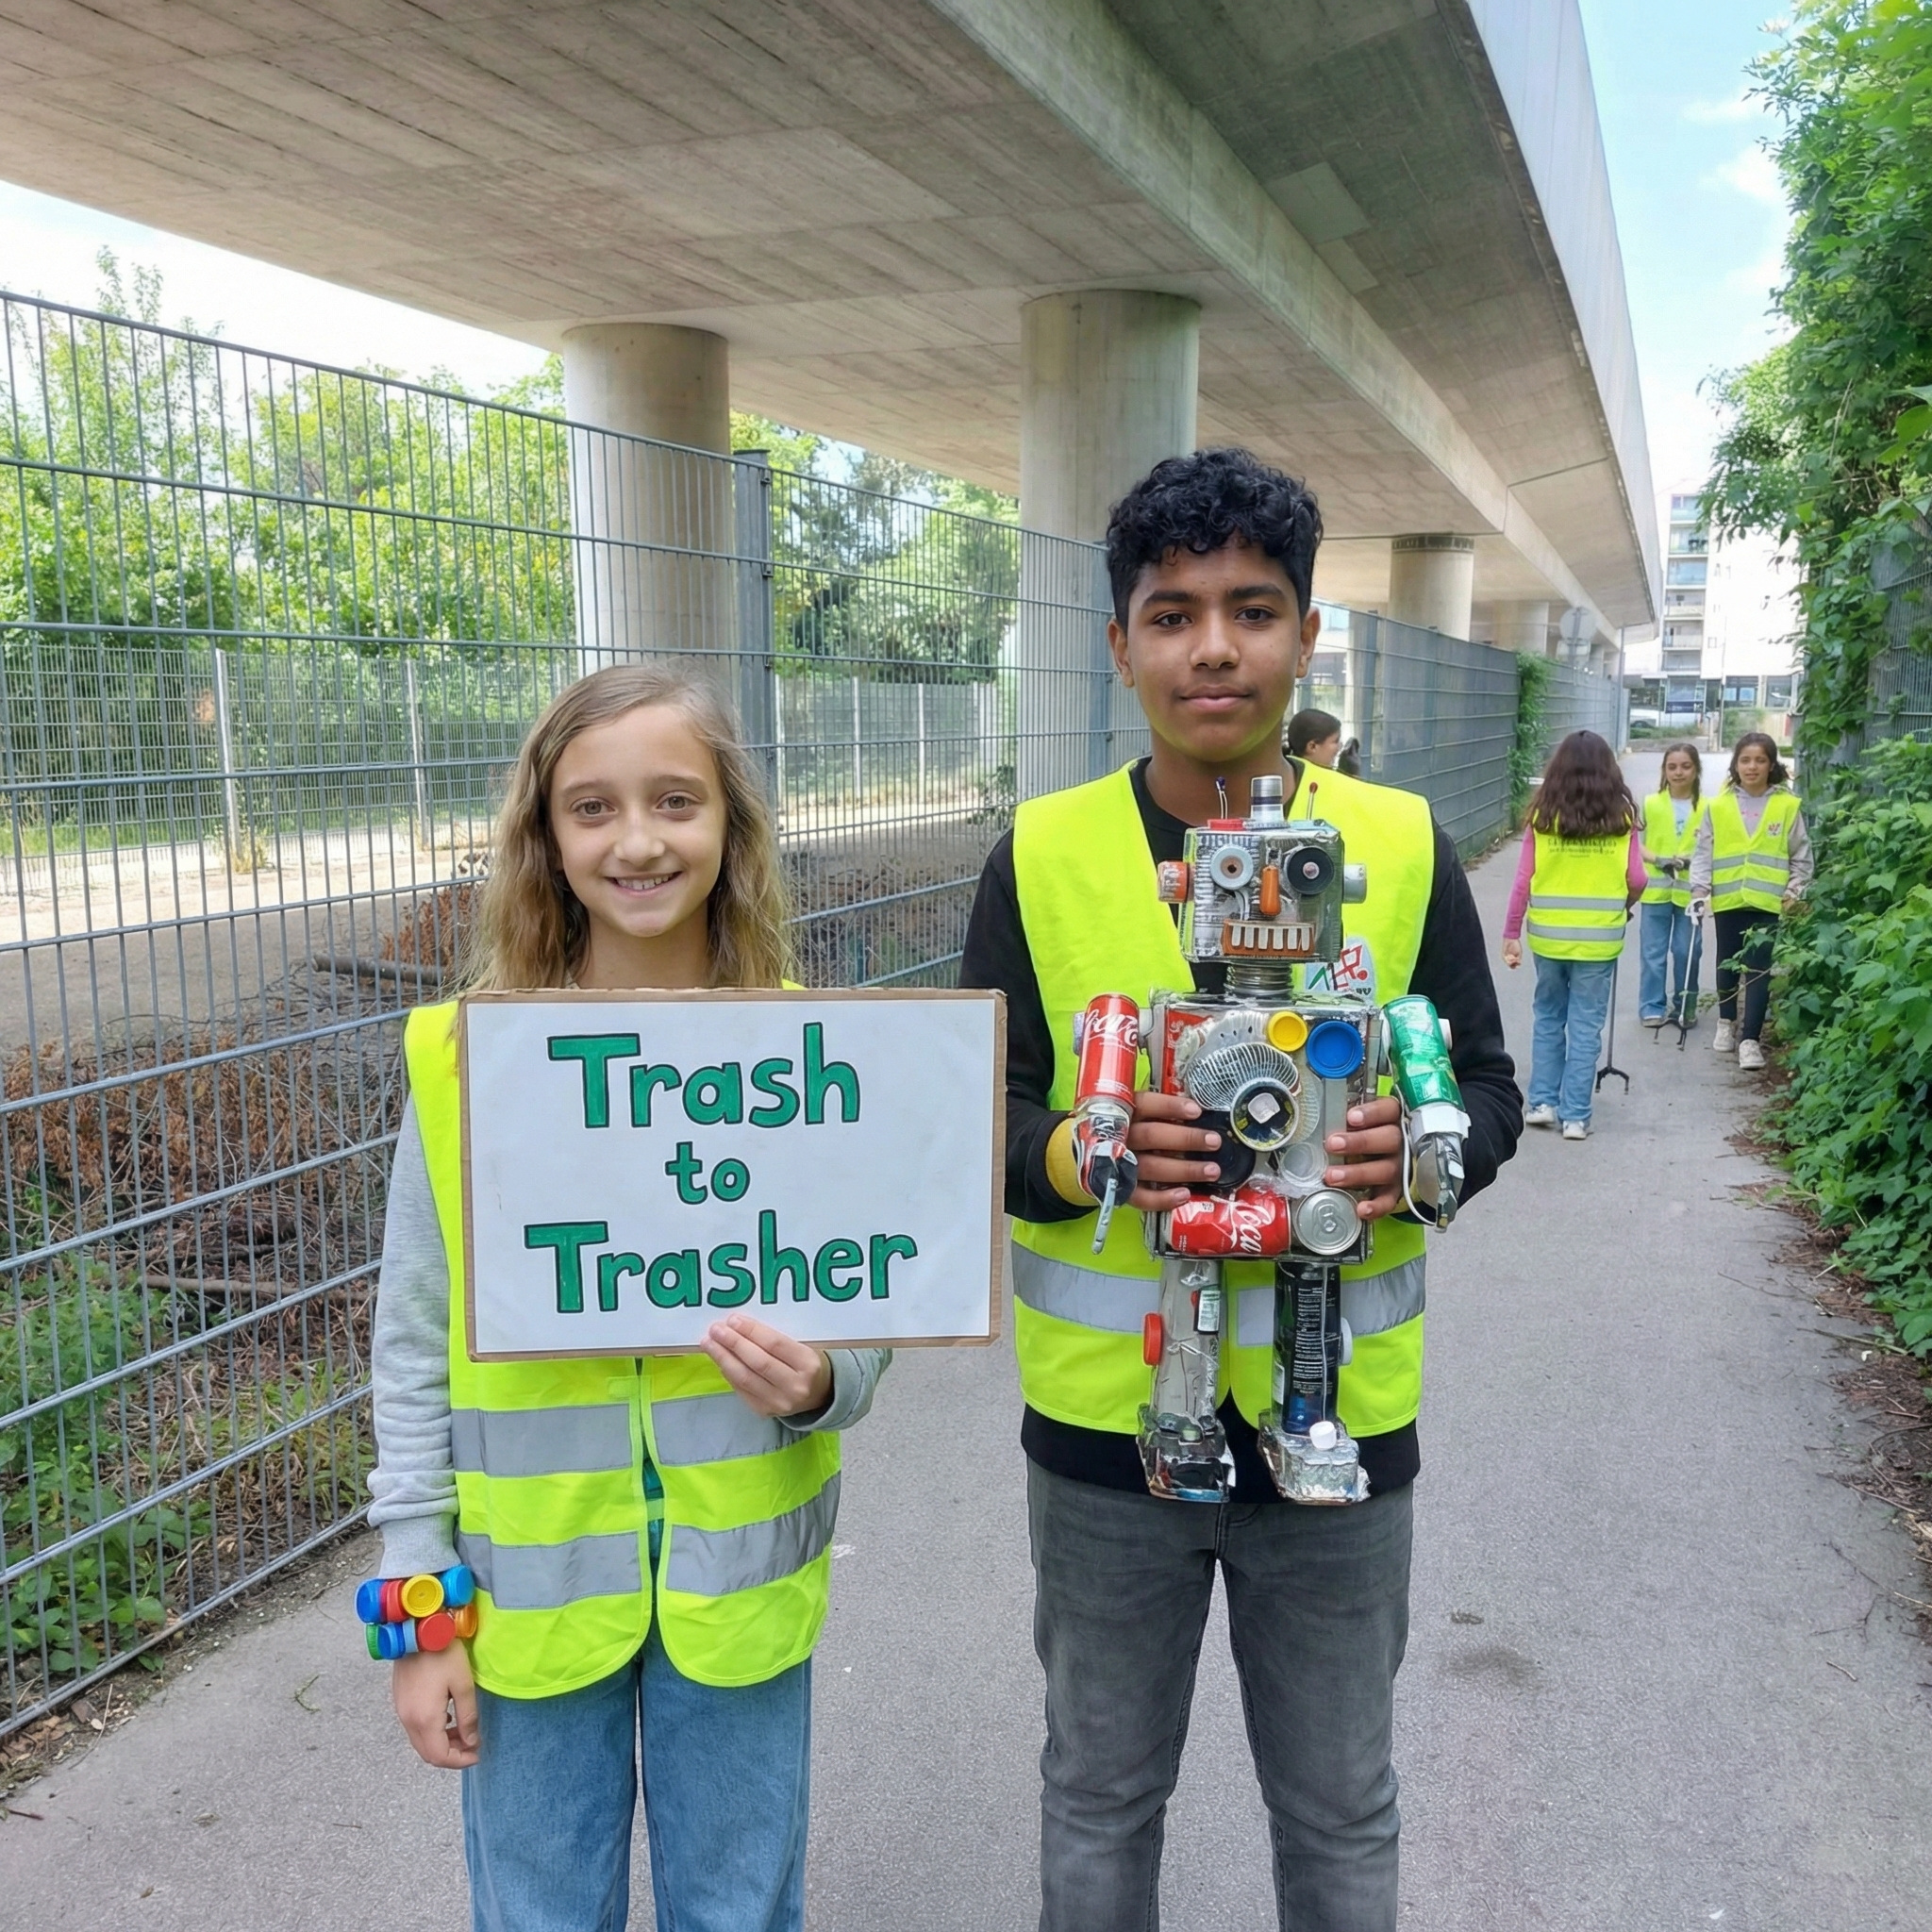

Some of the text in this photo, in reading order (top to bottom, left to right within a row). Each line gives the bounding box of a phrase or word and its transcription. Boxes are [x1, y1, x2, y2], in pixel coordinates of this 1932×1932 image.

[548, 1022, 860, 1128] Trash
[665, 1141, 750, 1204] to
[525, 1209, 918, 1313] Trasher
[1231, 1200, 1273, 1253] Coca
